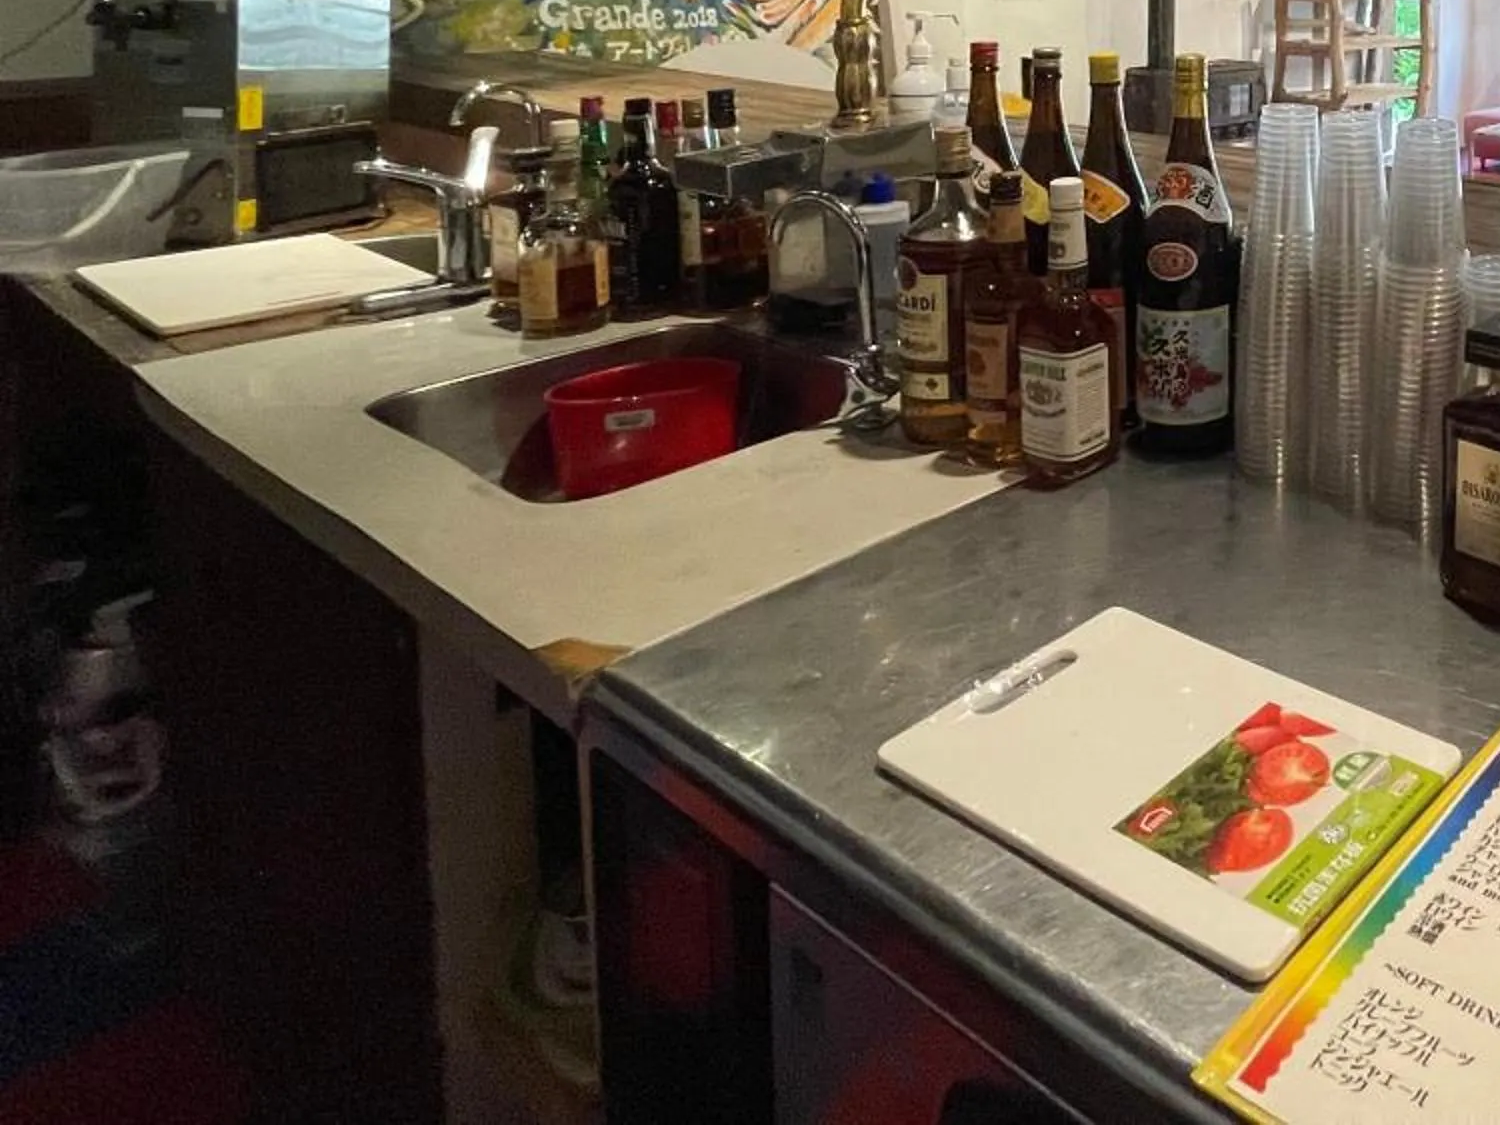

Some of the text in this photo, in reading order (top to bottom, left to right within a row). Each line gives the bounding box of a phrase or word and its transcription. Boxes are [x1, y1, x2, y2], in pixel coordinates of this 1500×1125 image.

[671, 6, 719, 28] 2018
[1446, 873, 1480, 891] and
[1362, 986, 1425, 1021] オレンジ
[1307, 1052, 1370, 1093] トニック
